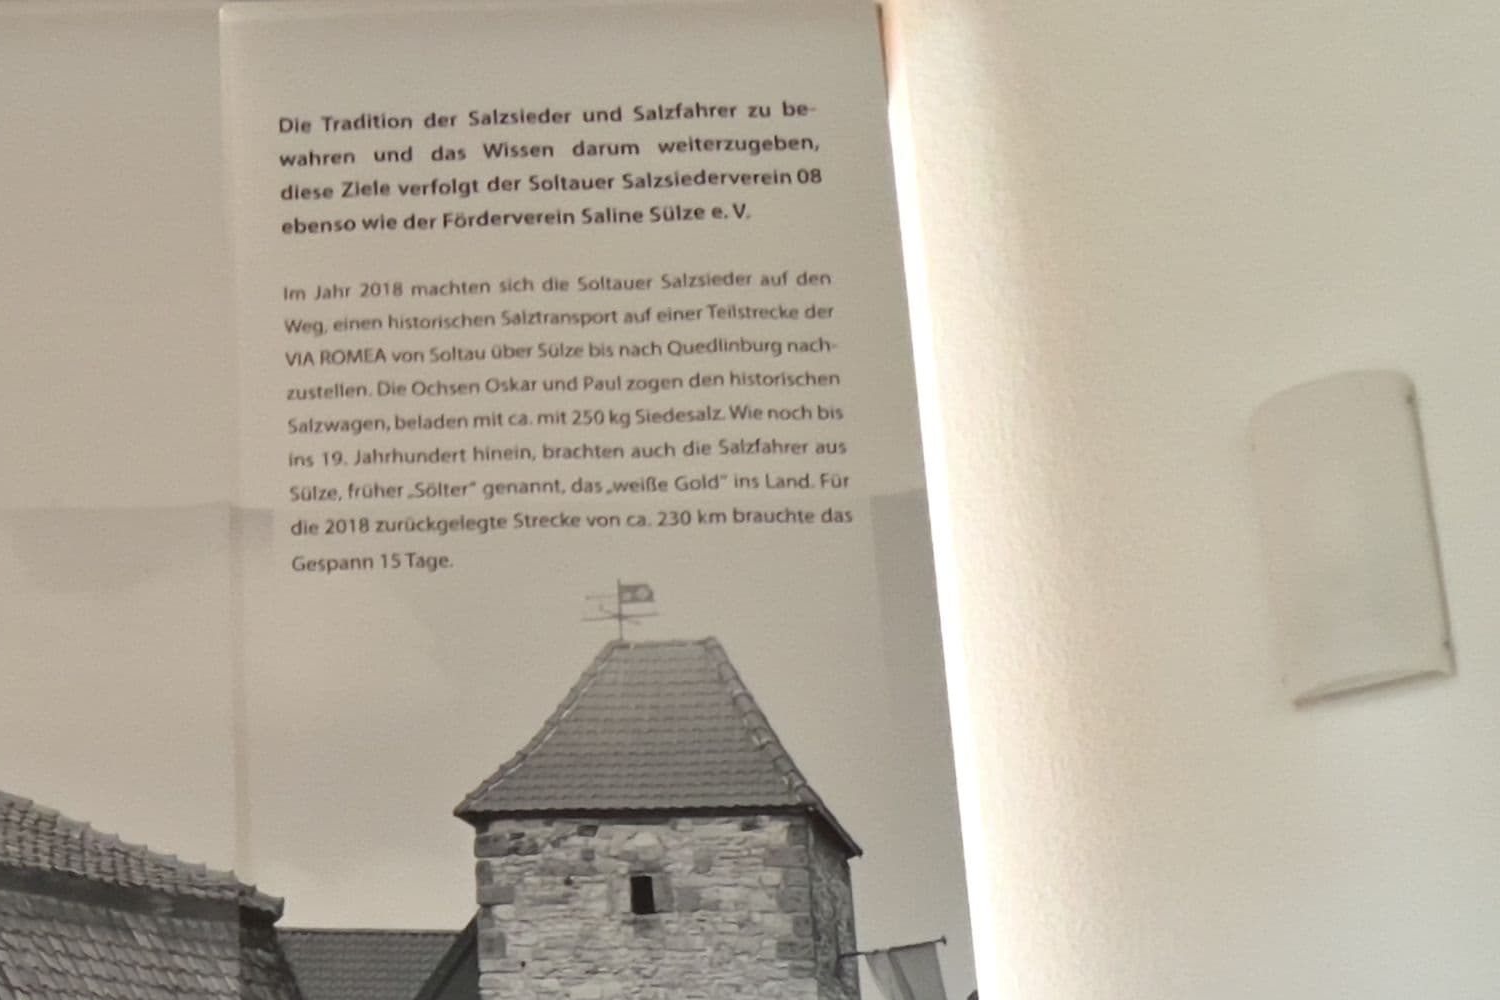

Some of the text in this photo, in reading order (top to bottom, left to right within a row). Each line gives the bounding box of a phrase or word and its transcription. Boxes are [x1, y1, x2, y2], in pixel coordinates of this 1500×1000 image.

[279, 100, 816, 134] Die Tradition der Salzsieder und Salzfahrer zu be-
[279, 135, 819, 167] wahren und das Wissen darum weiterzugeben,
[280, 168, 822, 201] diese Ziele verfolgt der Soltauer Salzsiederverein 08
[282, 217, 356, 235] ebenso
[362, 214, 397, 230] wie
[403, 213, 437, 230] der
[443, 209, 575, 229] Förderverein
[581, 207, 644, 224] Saline
[650, 204, 705, 223] Sülze
[284, 271, 831, 301] Im Jahr 2018 machten sich die Soltauer Salzsieder auf den
[333, 318, 382, 331] einen
[388, 313, 495, 330] historischen
[501, 310, 618, 328] Salztransport
[624, 307, 652, 324] auf
[657, 307, 703, 322] einer
[706, 304, 799, 320] Teilstrecke
[804, 304, 834, 319] der
[285, 352, 315, 367] VIA
[320, 348, 386, 365] ROMEA
[392, 351, 424, 362] von
[429, 346, 486, 362] Soltau
[491, 344, 533, 359] über
[538, 342, 584, 358] Sülze
[589, 342, 614, 357] bis
[619, 341, 662, 357] nach
[667, 337, 782, 357] Quedlinburg
[377, 380, 407, 397] Die
[412, 380, 480, 396] Ochsen
[485, 377, 537, 393] Oskar
[542, 376, 578, 392] und
[583, 376, 621, 391] Paul
[627, 377, 683, 394] zogen
[689, 372, 724, 388] den
[730, 371, 840, 386] historischen
[288, 418, 390, 435] Salzwagen,
[395, 414, 468, 430] beladen
[473, 412, 503, 428] mit
[537, 411, 566, 424] mit
[572, 410, 605, 425] 250
[609, 409, 631, 428] kg
[729, 405, 763, 420] Wie
[767, 405, 812, 420] noch
[817, 405, 844, 420] bis
[289, 453, 314, 467] ins
[354, 448, 466, 466] Jahrhundert
[473, 446, 536, 461] hinein,
[542, 443, 624, 459] brachten
[631, 442, 676, 458] auch
[683, 440, 711, 456] die
[719, 438, 808, 455] Salzfahrer
[815, 442, 847, 454] aus
[290, 485, 342, 502] Sülze,
[348, 482, 404, 499] früher
[483, 480, 566, 499] genannt,
[571, 477, 603, 493] das
[734, 475, 759, 488] ins
[820, 473, 849, 488] Für
[291, 520, 319, 536] die
[325, 517, 369, 535] 2018
[376, 515, 507, 536] zurückgelegte
[513, 512, 581, 528] Strecke
[586, 516, 620, 528] von
[658, 510, 692, 527] 230
[697, 509, 727, 524] km
[732, 507, 815, 524] brauchte
[821, 507, 852, 523] das
[292, 556, 374, 574] Gespann
[380, 553, 401, 569] 15
